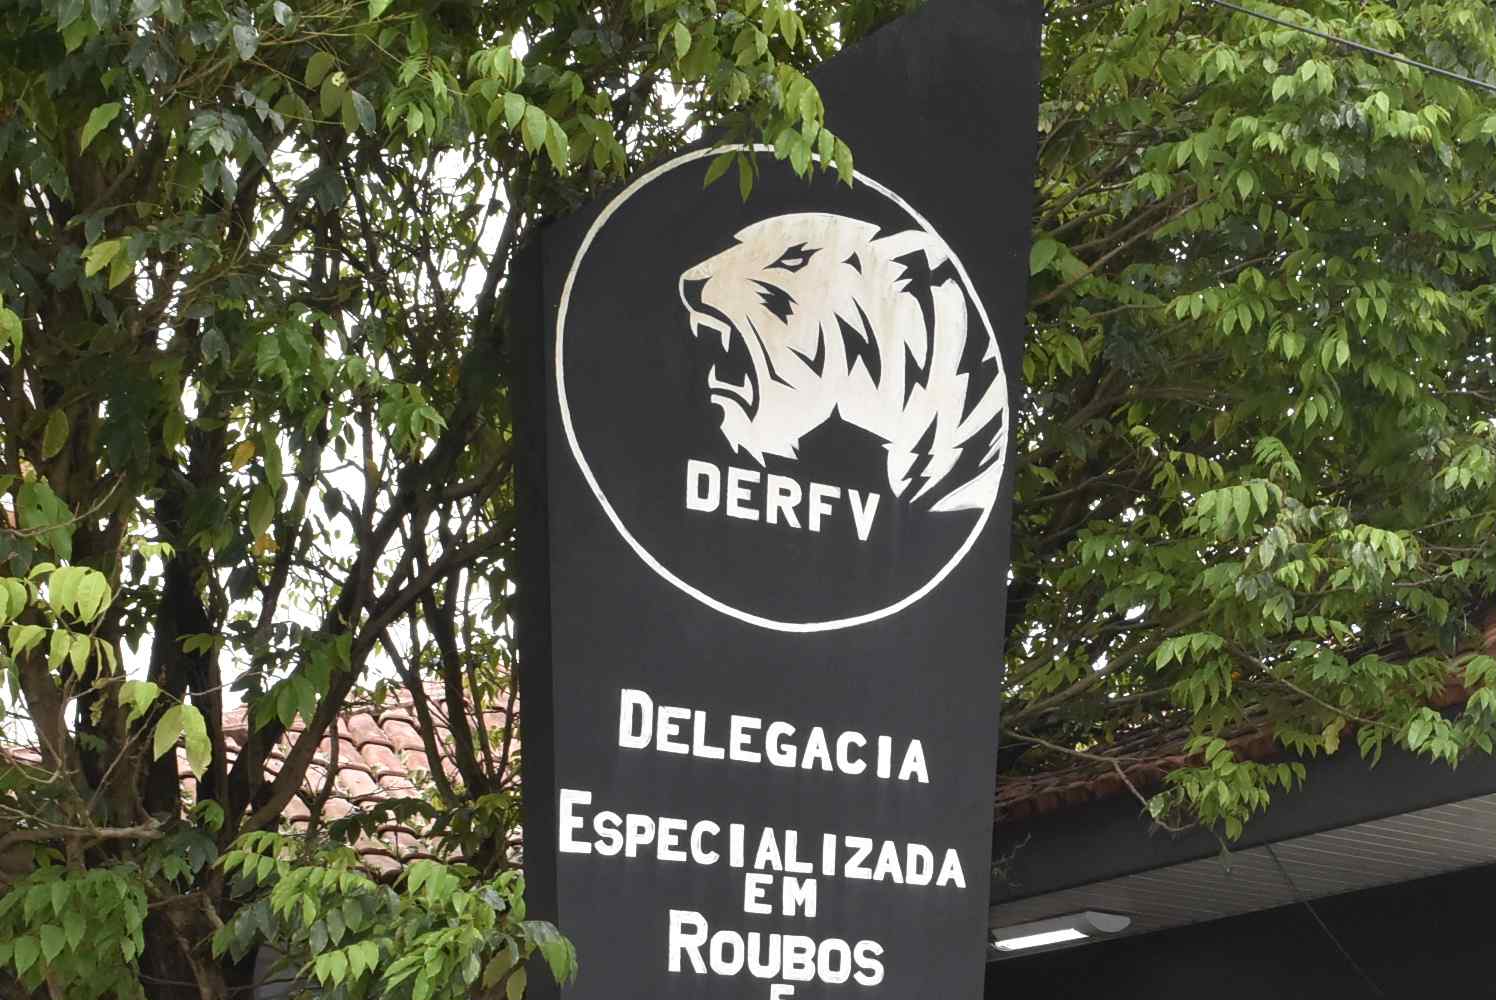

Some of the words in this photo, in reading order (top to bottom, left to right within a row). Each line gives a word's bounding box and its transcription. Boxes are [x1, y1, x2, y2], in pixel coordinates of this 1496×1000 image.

[686, 460, 881, 541] DERFV
[618, 688, 930, 784] DELEGACIA
[558, 788, 967, 889] ESPECIALIZADA
[743, 872, 818, 918] EM
[667, 908, 885, 987] ROUBOS
